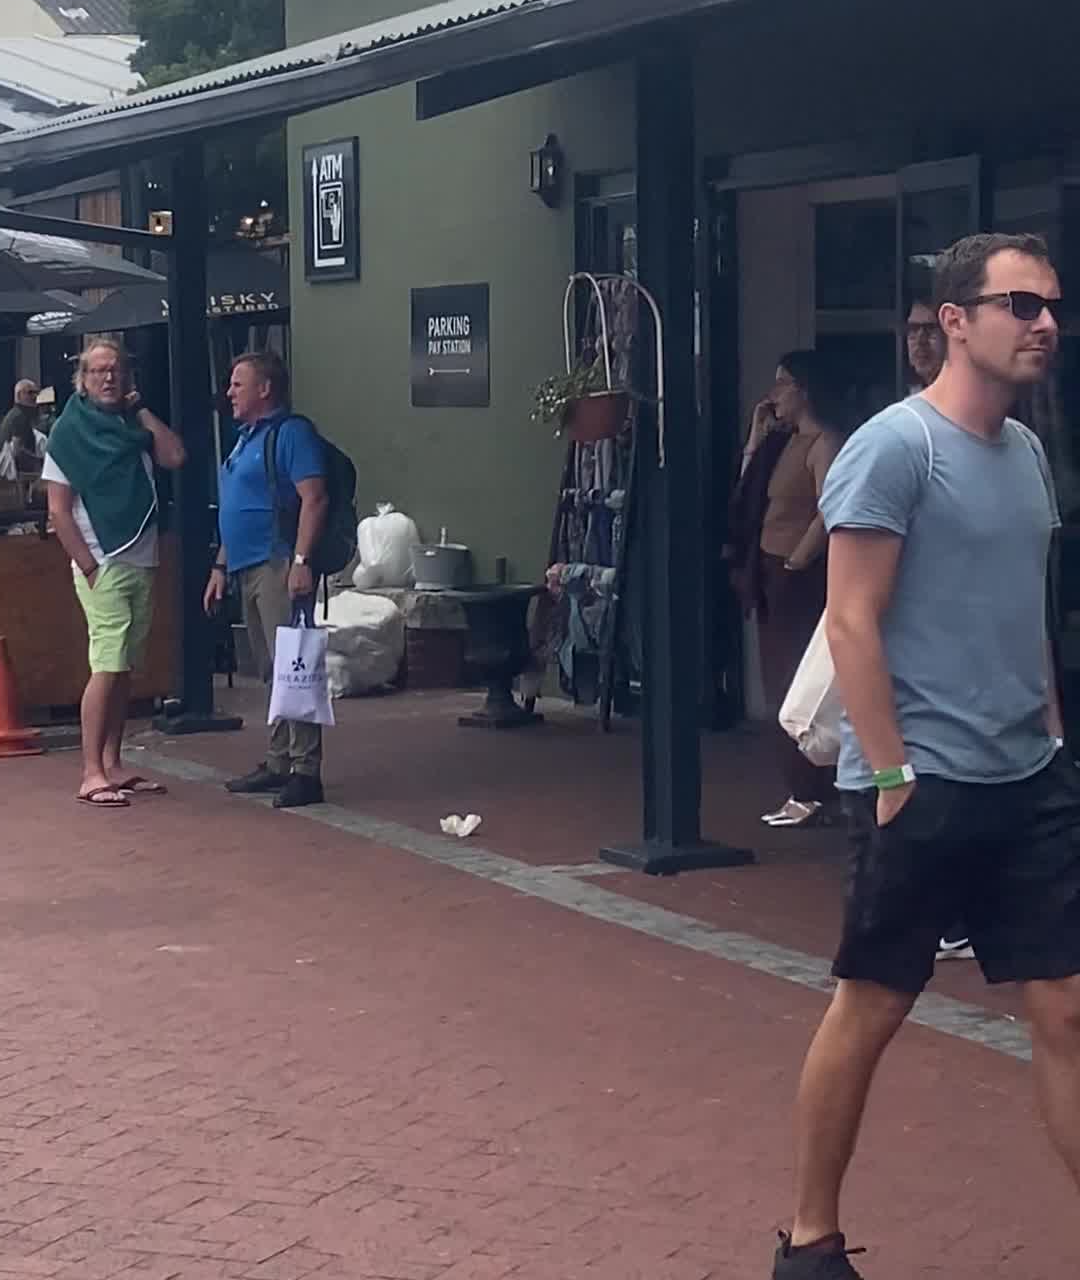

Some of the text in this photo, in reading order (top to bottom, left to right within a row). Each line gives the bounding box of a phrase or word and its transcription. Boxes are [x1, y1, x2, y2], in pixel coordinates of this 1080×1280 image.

[320, 153, 343, 181] ATM
[428, 315, 470, 337] PARKING
[428, 339, 471, 355] PAY STATION
